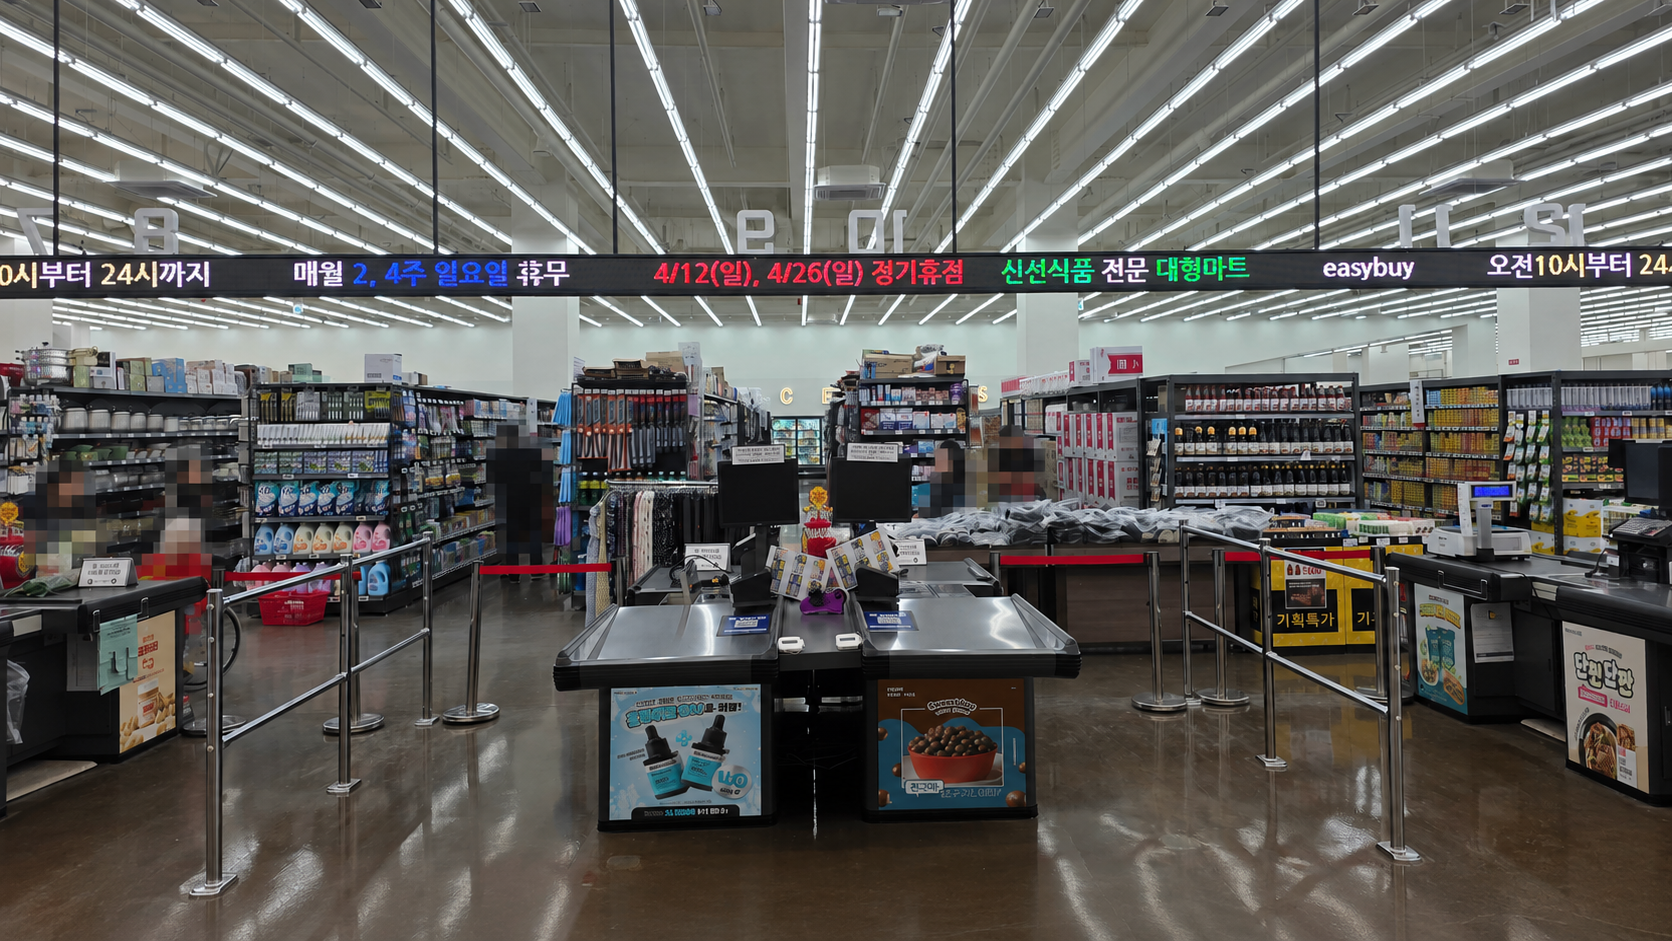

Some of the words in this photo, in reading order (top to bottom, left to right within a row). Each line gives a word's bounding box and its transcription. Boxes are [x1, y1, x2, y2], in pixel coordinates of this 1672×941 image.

[101, 261, 210, 289] 24시까지
[294, 260, 343, 287] 매월
[353, 262, 377, 288] 2,
[385, 260, 427, 287] 4주
[434, 260, 508, 287] 일요일
[516, 260, 570, 287] 휴무
[653, 258, 760, 287] 4/12(일),
[767, 260, 864, 287] 4/26(일)
[872, 259, 964, 286] 정기휴점
[1001, 258, 1095, 286] 신선식품
[1101, 257, 1149, 284] 전문
[1156, 255, 1250, 283] 대형마트
[1322, 255, 1416, 281] easybuy
[1487, 252, 1632, 280] 오전10시부터
[1639, 253, 1672, 275] 24
[1277, 612, 1335, 628] 기획특가
[1357, 611, 1375, 626] 기
